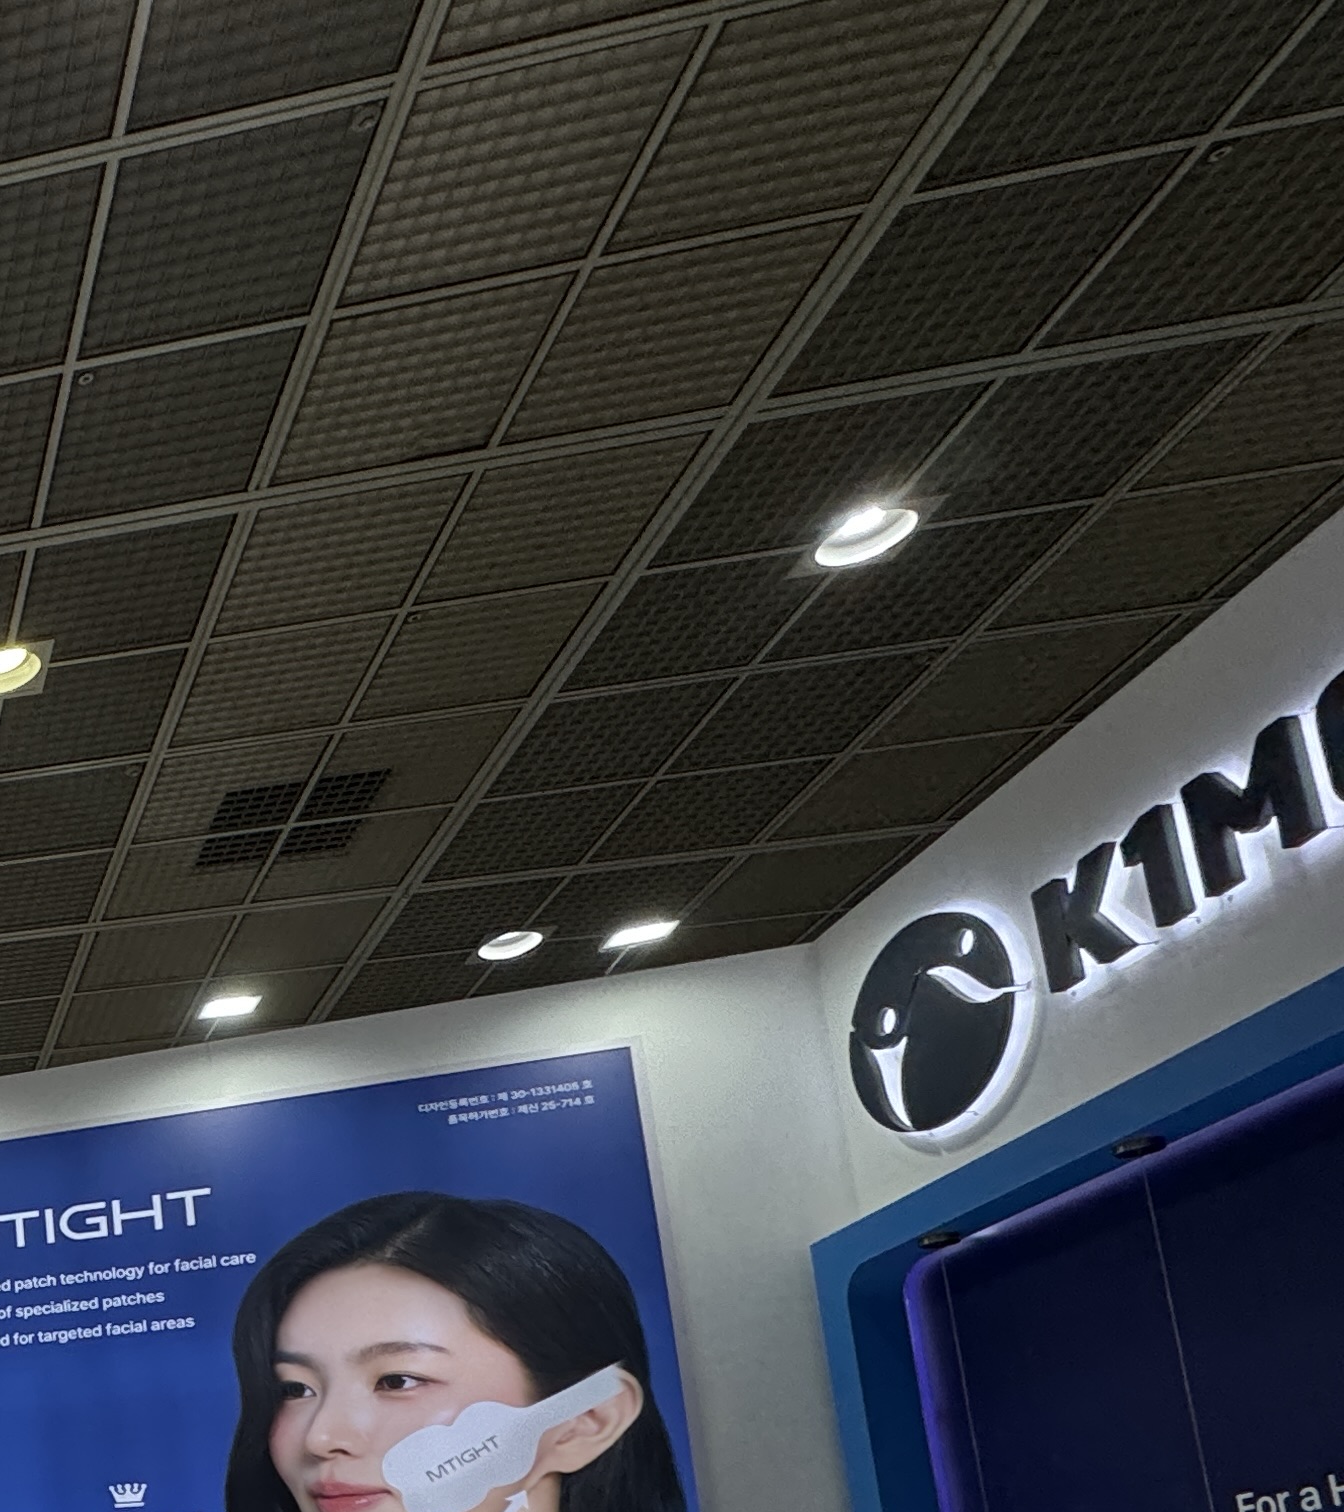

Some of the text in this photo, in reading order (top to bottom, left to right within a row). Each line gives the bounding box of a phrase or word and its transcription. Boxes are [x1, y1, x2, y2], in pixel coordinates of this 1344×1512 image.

[14, 1274, 57, 1294] patch
[60, 1263, 145, 1285] technology
[148, 1261, 170, 1275] for
[174, 1255, 217, 1272] facial
[220, 1252, 257, 1267] care
[15, 1296, 100, 1320] specialized
[102, 1289, 166, 1312] patches
[13, 1331, 35, 1346] for
[37, 1324, 103, 1345] targeted
[105, 1319, 148, 1336] facial
[150, 1315, 196, 1332] areas
[425, 1434, 499, 1483] MTIGHT
[1299, 1485, 1323, 1512] a
